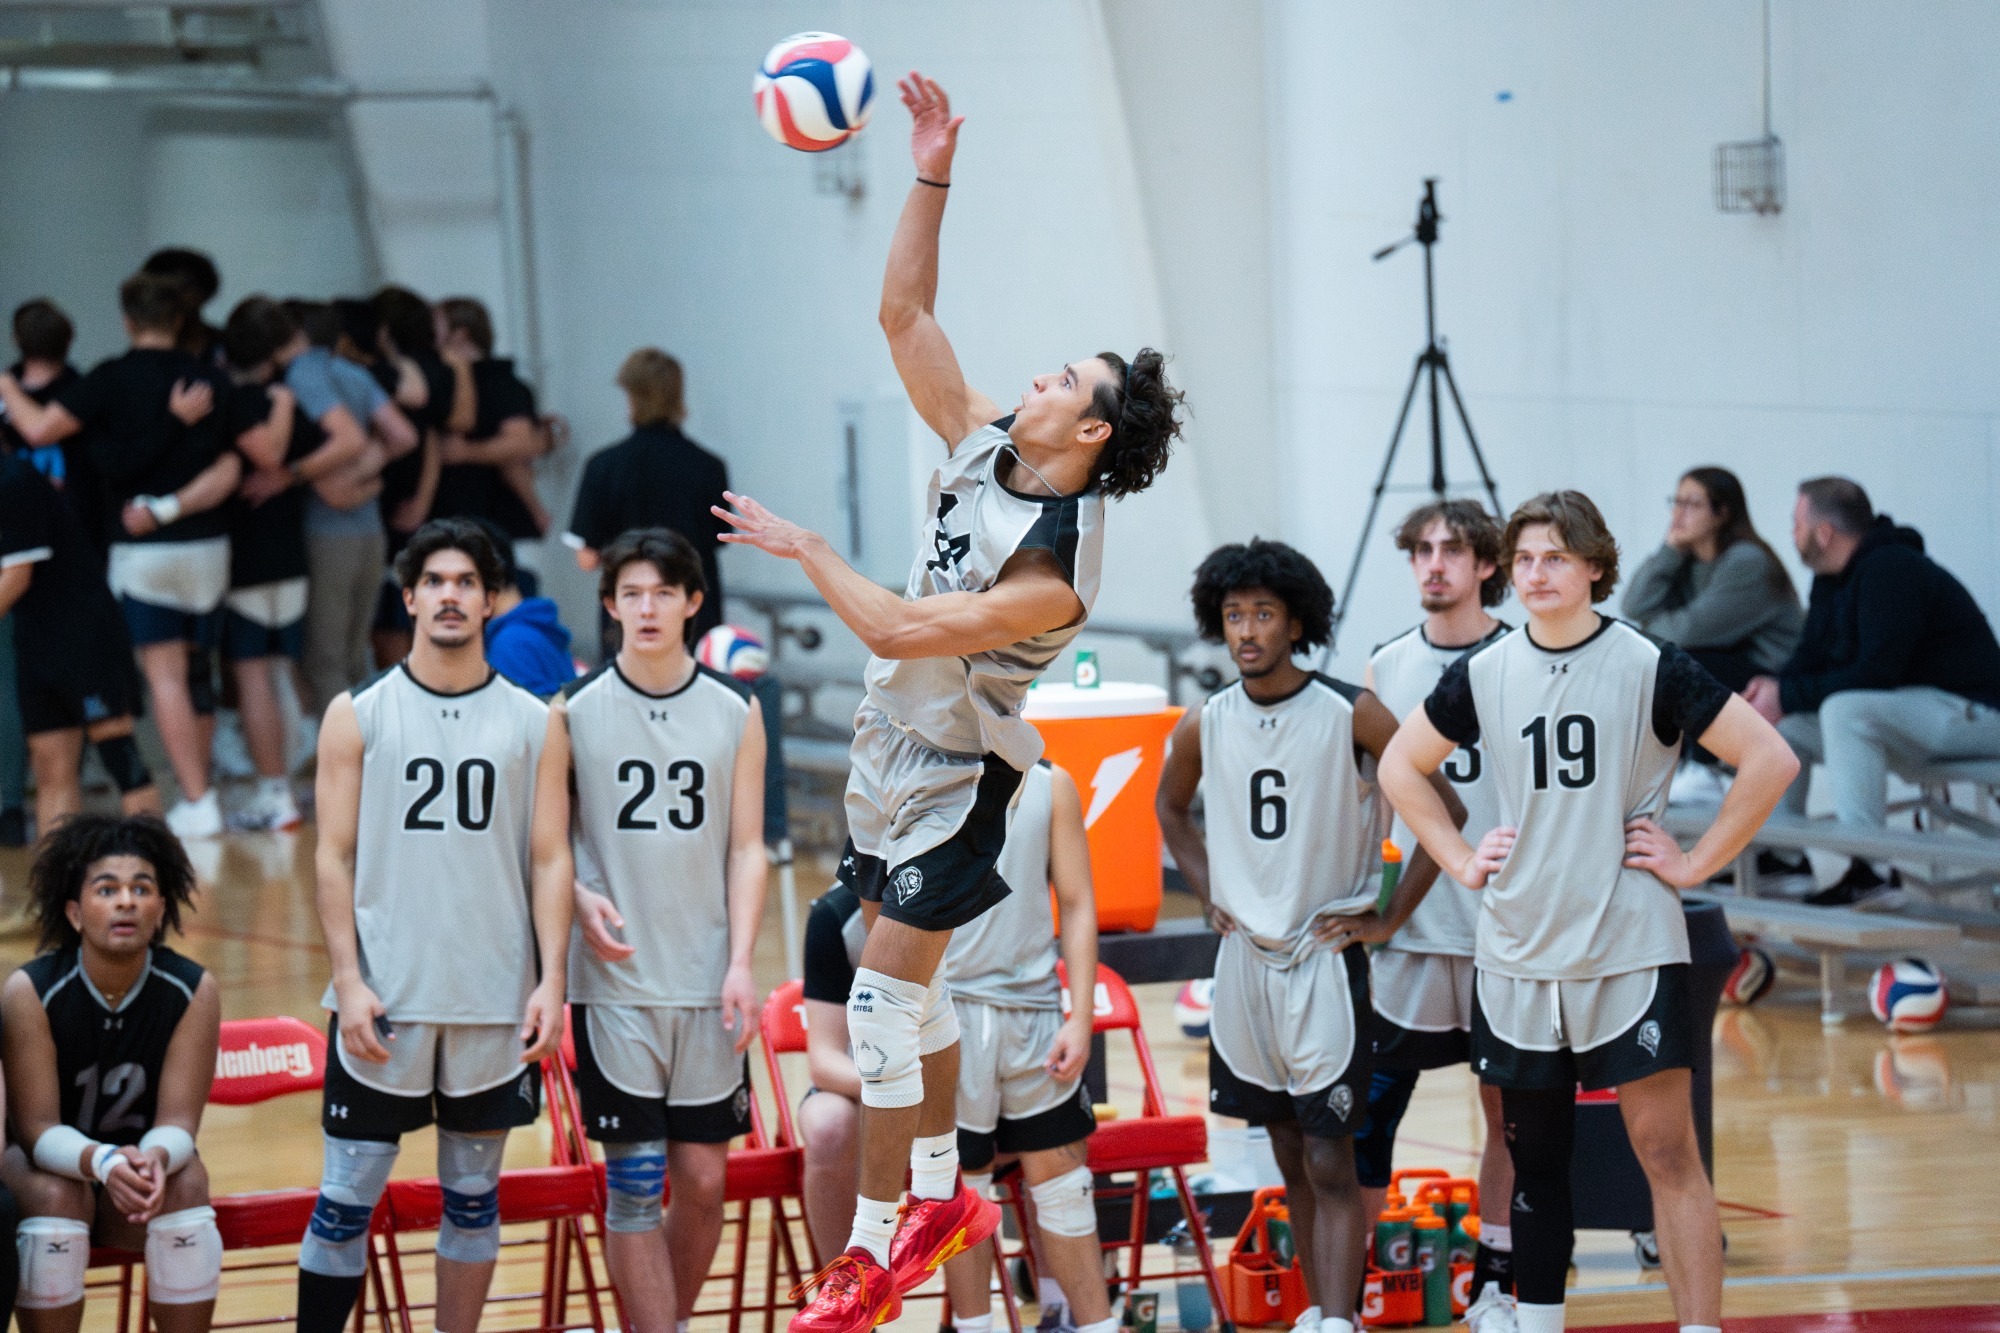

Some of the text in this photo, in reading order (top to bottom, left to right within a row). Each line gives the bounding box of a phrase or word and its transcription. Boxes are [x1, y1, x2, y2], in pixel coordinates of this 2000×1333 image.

[1521, 714, 1596, 790] 19
[404, 756, 496, 831] 20
[617, 759, 705, 831] 23
[1250, 768, 1287, 840] 6
[76, 1061, 147, 1132] 12
